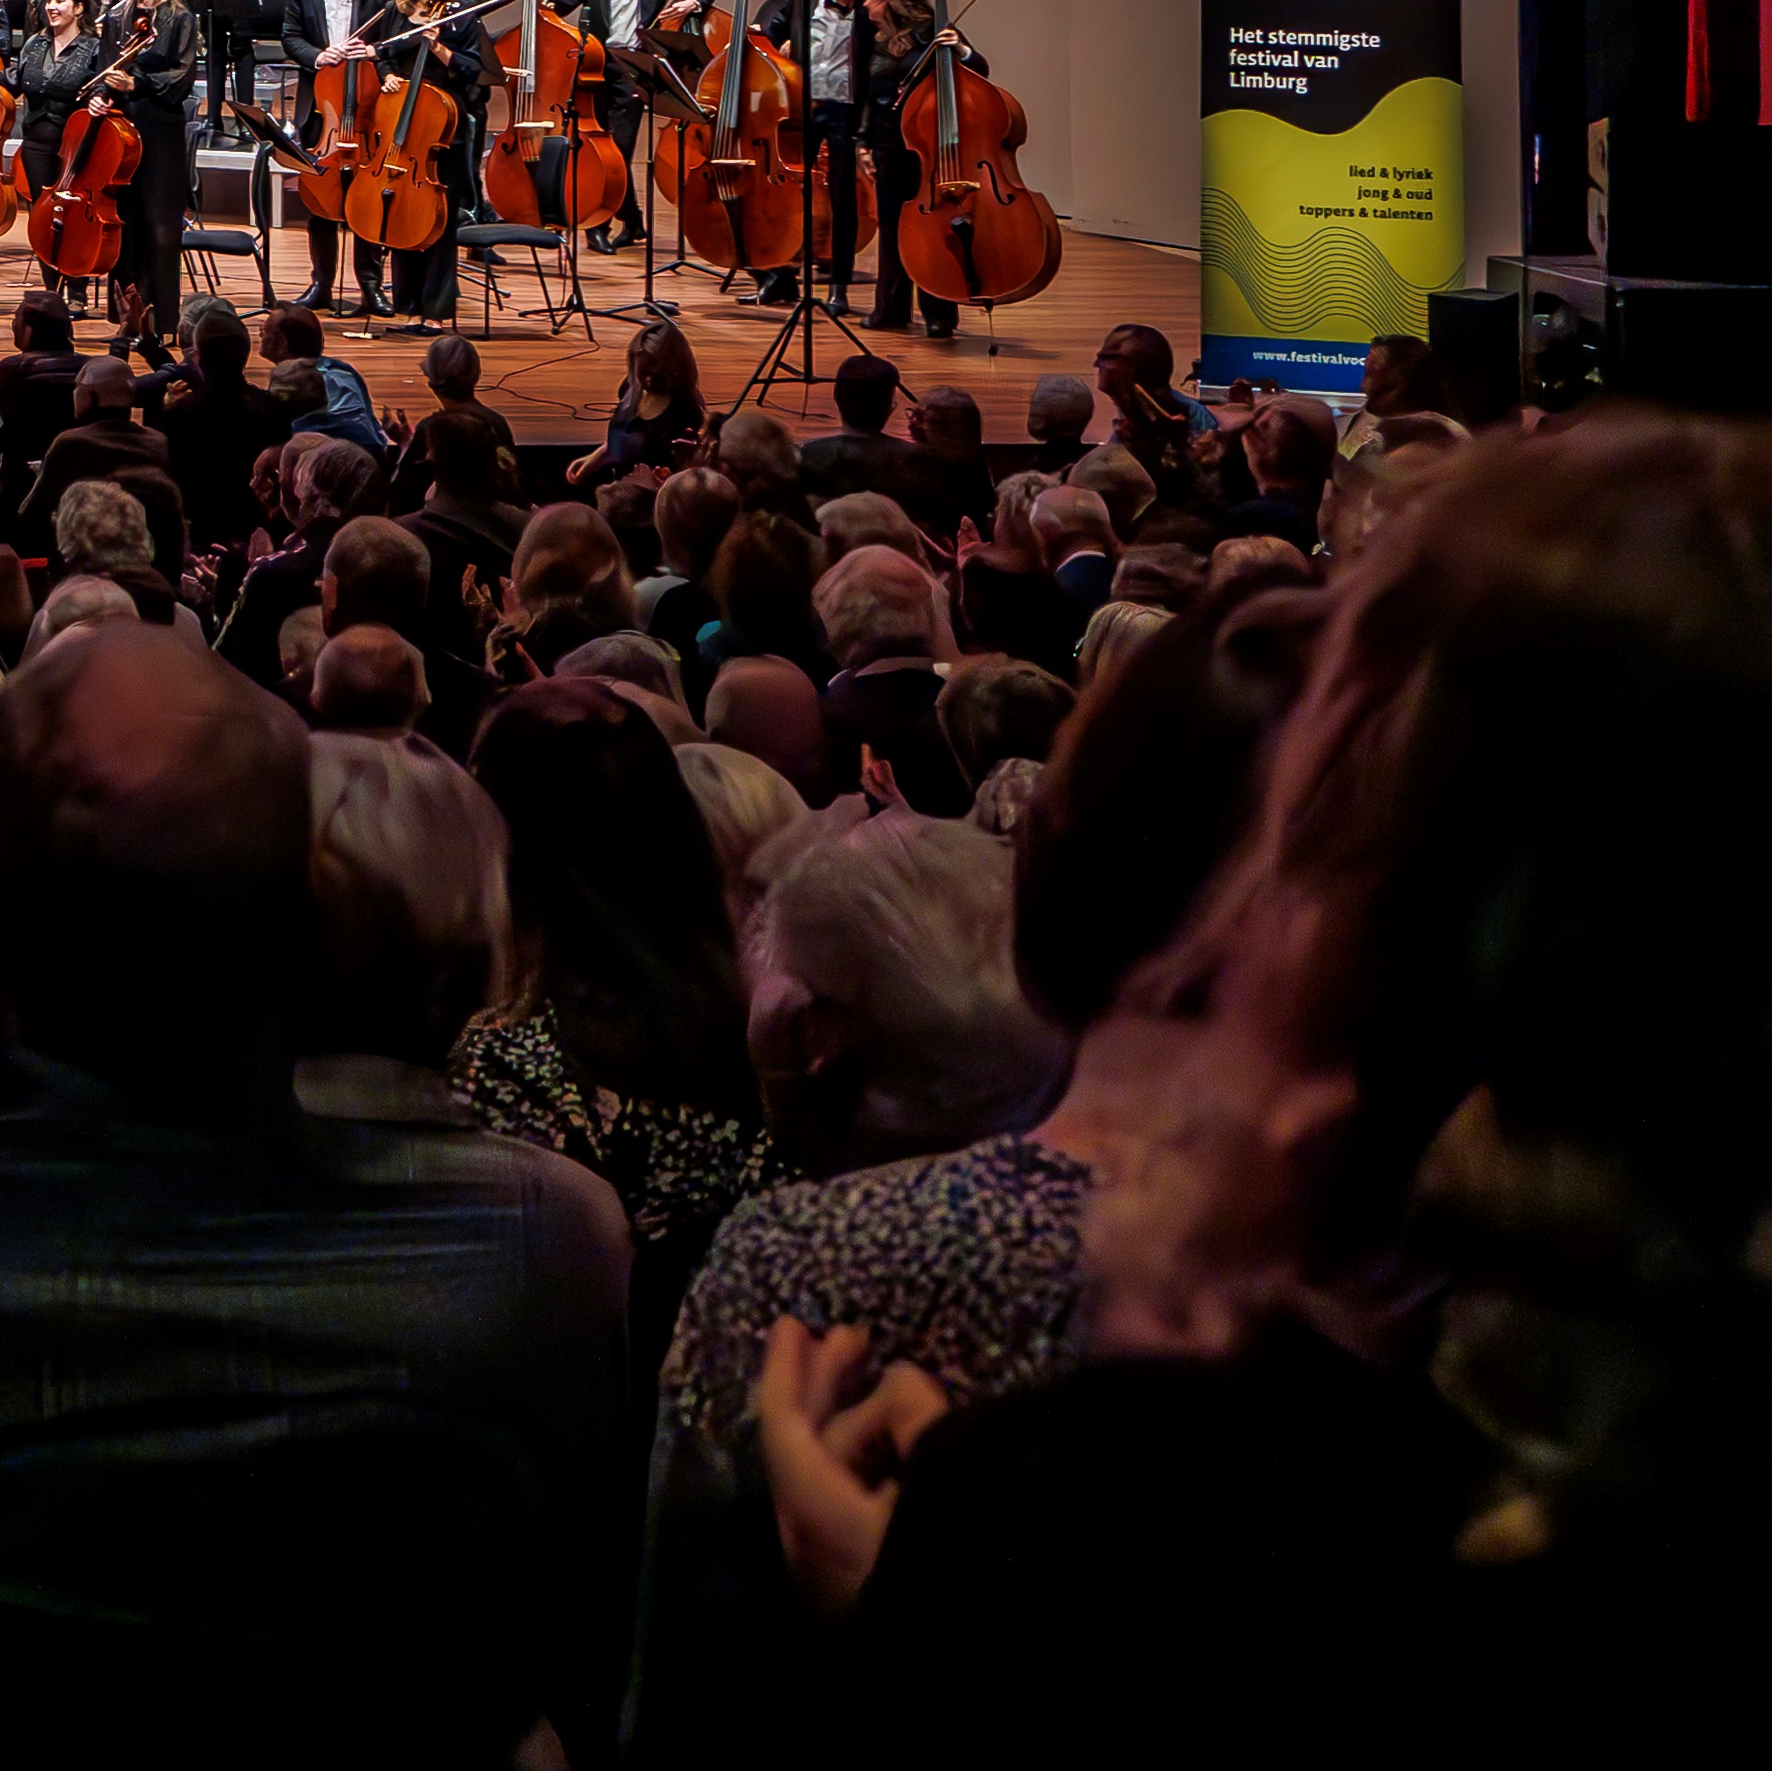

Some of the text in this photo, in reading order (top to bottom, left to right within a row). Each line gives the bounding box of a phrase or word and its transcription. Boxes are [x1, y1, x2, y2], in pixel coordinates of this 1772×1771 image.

[1229, 27, 1381, 50] Het stemmigste
[1229, 49, 1339, 69] festival van
[1229, 71, 1308, 94] Limburg
[1349, 165, 1434, 181] lied & lyriek
[1357, 185, 1433, 201] jong & oud
[1299, 205, 1433, 221] toppers & talenten
[1252, 351, 1367, 366] www.festivalvoc
